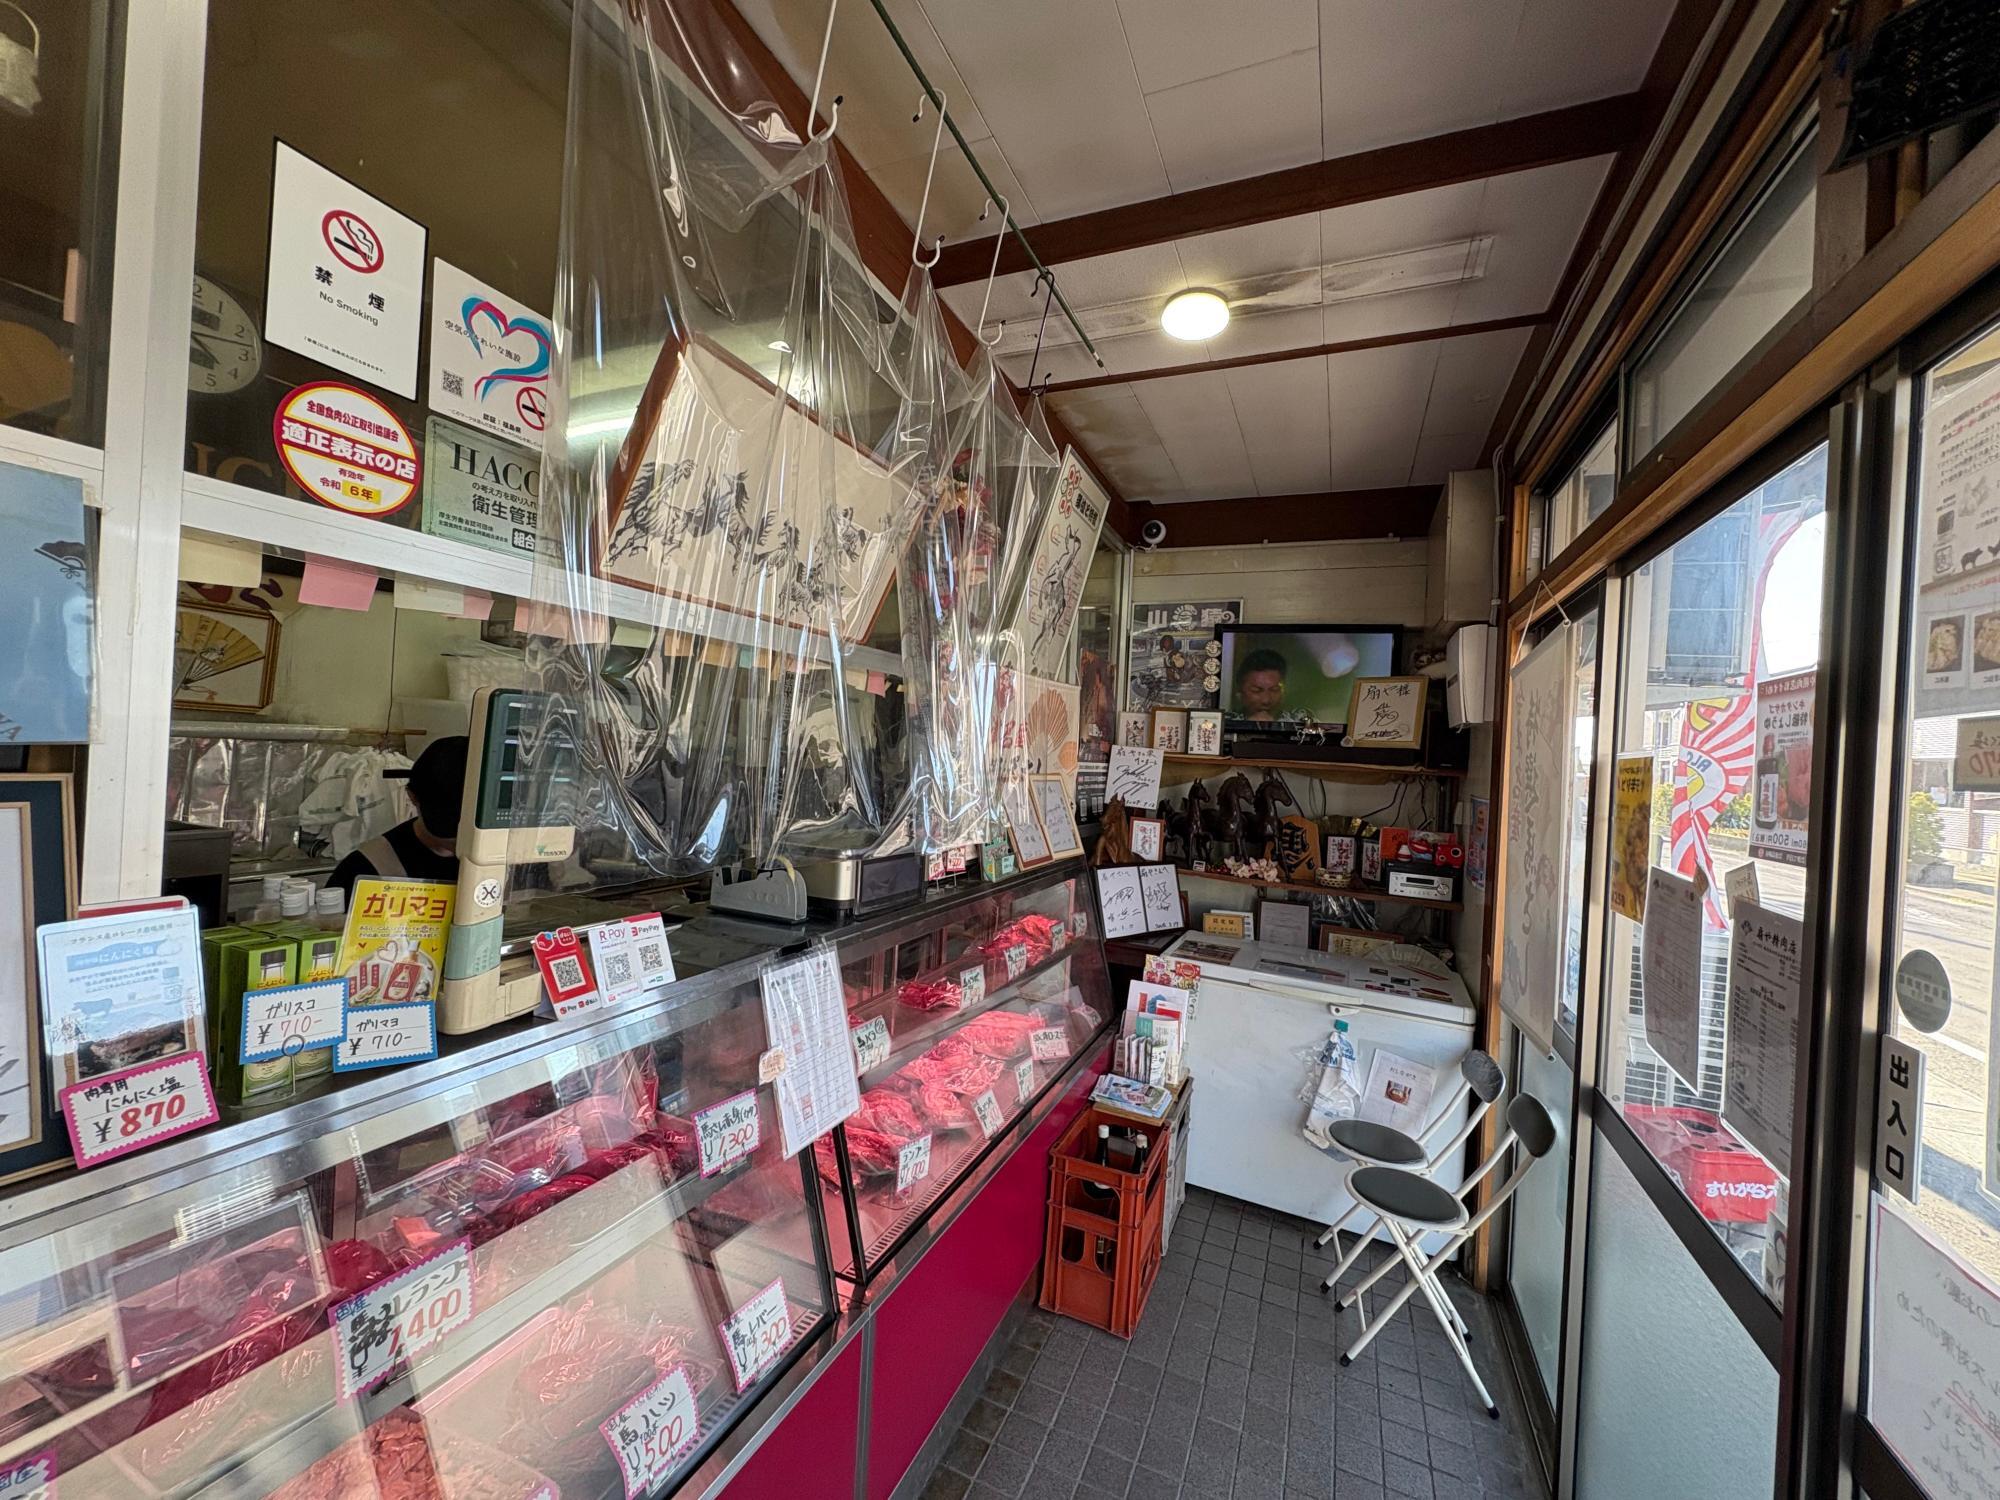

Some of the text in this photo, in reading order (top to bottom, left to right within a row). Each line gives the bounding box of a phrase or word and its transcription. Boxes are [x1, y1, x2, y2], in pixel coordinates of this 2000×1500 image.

[319, 291, 379, 326] No Smoking
[234, 324, 245, 338] 2
[444, 319, 521, 363] 空気のきれいな施設
[238, 350, 249, 361] 3
[205, 373, 217, 387] 5
[227, 367, 238, 380] 4
[306, 400, 399, 443] 全国食肉公正取引協議会
[282, 418, 416, 480] 適正表示の店
[338, 467, 366, 482] 有効年
[319, 477, 374, 501] 令和 6年
[363, 893, 449, 919] ガリマヨ
[608, 928, 626, 940] Pay
[638, 924, 660, 934] PayPay
[265, 999, 316, 1020] ガリスコ
[356, 1017, 399, 1032] ガリマヨ
[105, 1075, 185, 1113] にんにく塩
[1885, 1053, 1909, 1181] 出入口
[620, 1391, 677, 1451] 馬ハツ
